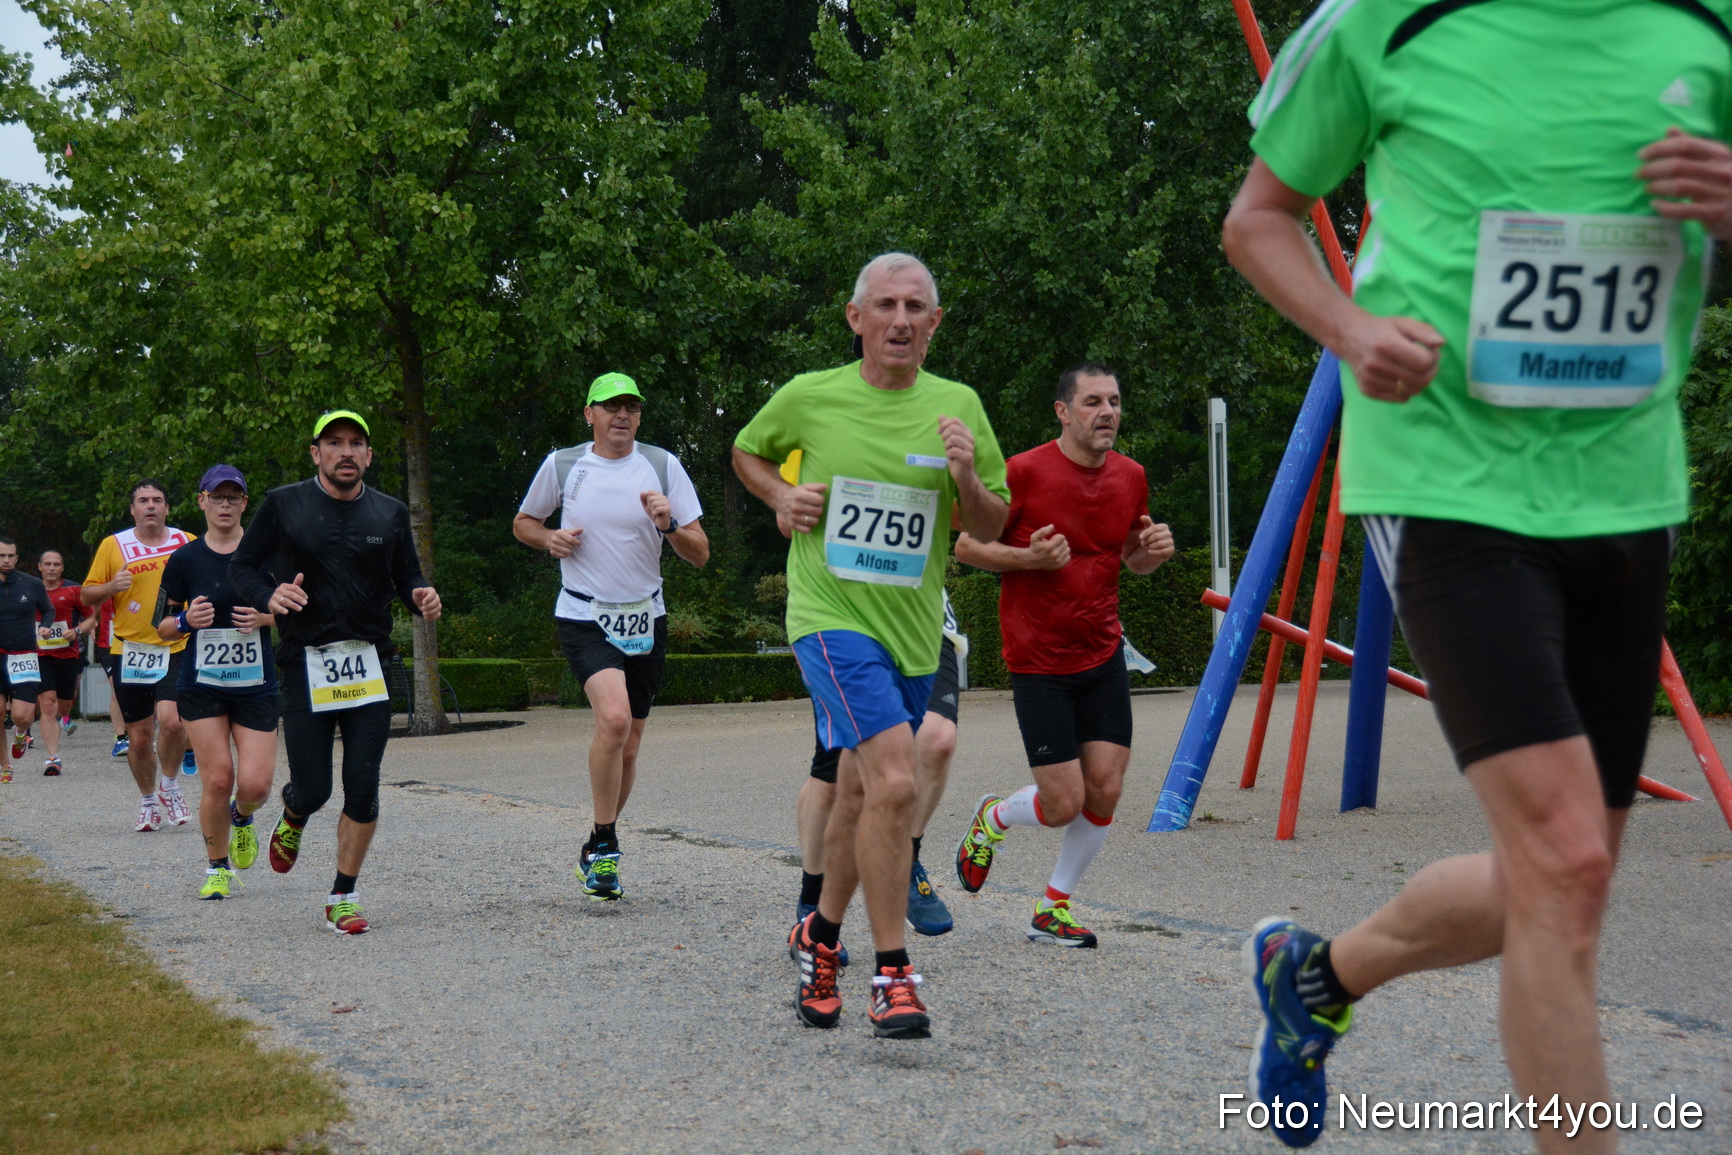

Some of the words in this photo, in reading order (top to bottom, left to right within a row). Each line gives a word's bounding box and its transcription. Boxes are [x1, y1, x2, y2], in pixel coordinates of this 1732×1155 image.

[1496, 262, 1660, 333] 2513
[1519, 352, 1625, 380] Manfred
[882, 487, 929, 504] BOCK
[838, 504, 925, 549] 2759
[128, 561, 159, 575] MAX
[855, 552, 898, 572] Alfons
[599, 612, 649, 636] 2428
[128, 651, 164, 668] 2781
[204, 642, 257, 665] 2235
[12, 660, 38, 672] 2653
[221, 670, 241, 679] Anni
[324, 654, 367, 683] 344
[333, 687, 367, 699] Marcus
